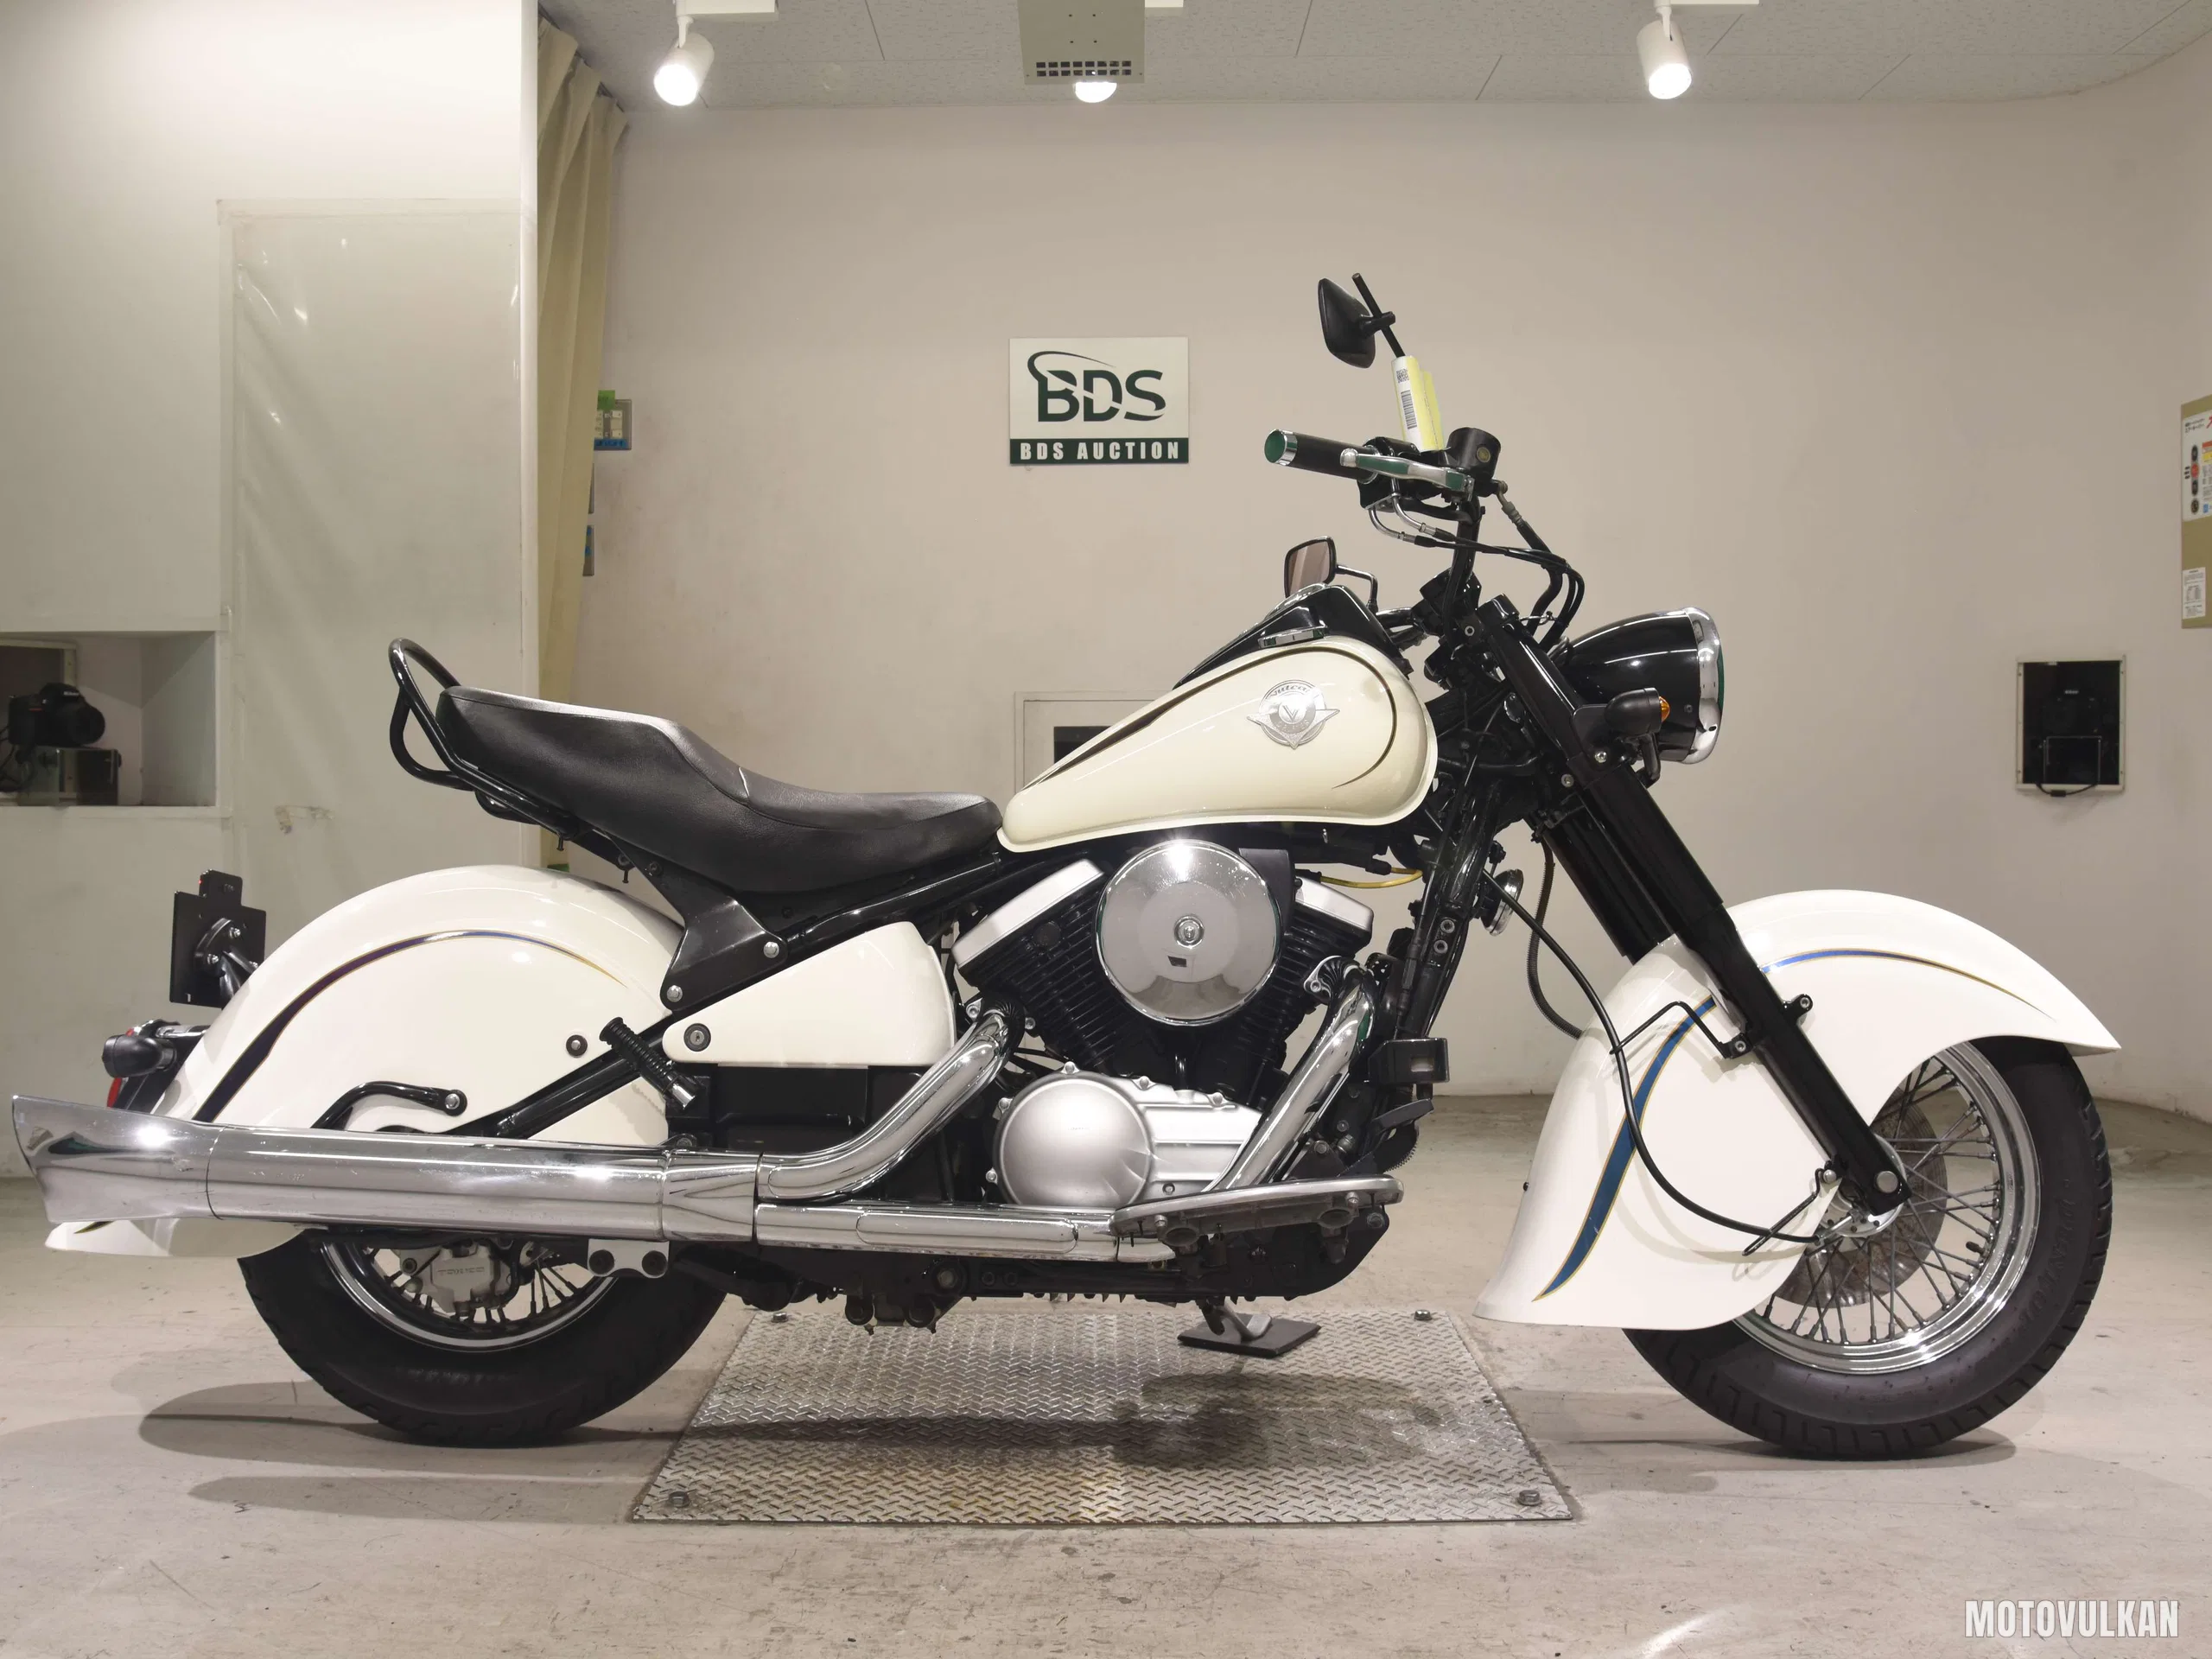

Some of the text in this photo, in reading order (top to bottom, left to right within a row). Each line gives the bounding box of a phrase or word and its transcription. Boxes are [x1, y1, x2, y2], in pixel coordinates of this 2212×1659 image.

[1027, 351, 1166, 422] BDS
[1020, 441, 1179, 461] BDS AUCTION
